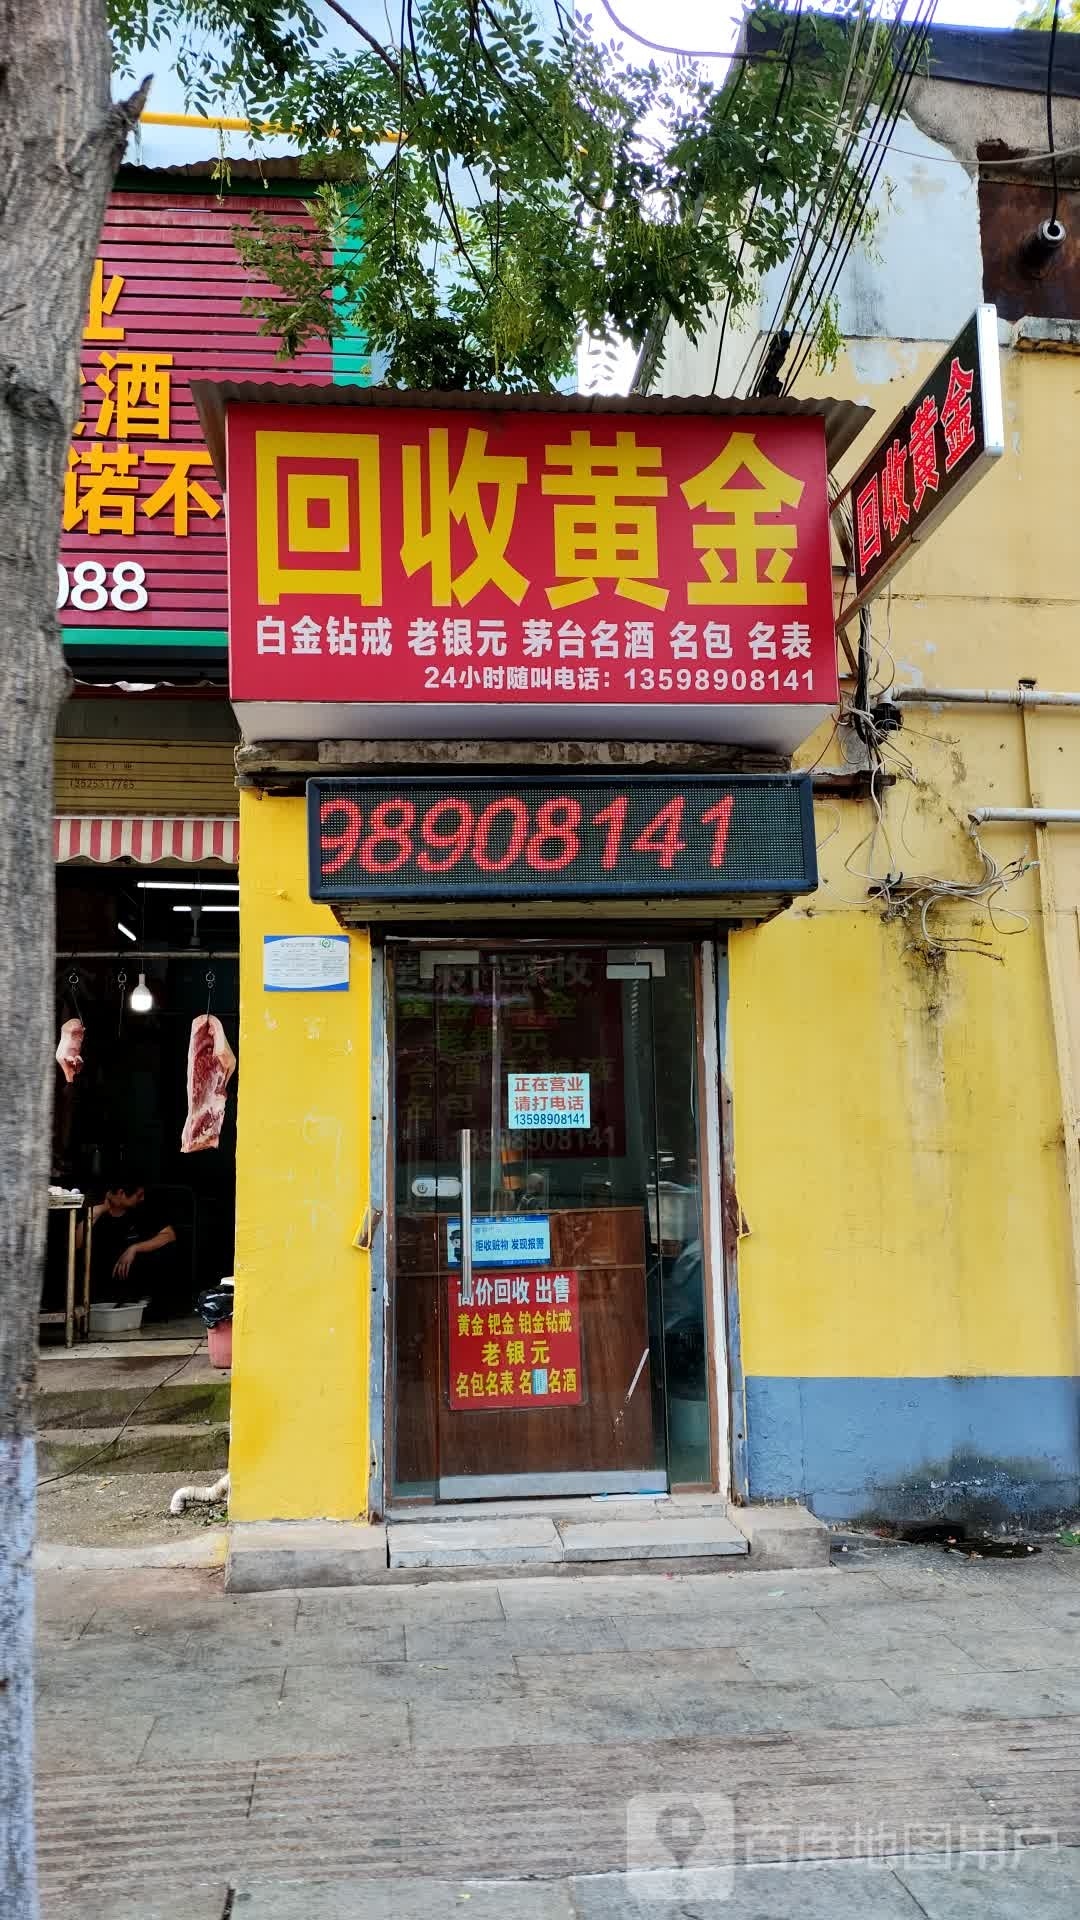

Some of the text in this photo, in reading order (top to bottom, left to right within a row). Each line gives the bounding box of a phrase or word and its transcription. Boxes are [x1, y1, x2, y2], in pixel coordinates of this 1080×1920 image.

[74, 351, 173, 440] 酒
[857, 356, 975, 577] 回收黄金
[255, 427, 808, 612] 回收黄金
[256, 615, 812, 661] 白金钻戒 老银元 茅台名酒 名包 名表
[320, 795, 734, 873] 98908141
[514, 1076, 584, 1092] 正在营业
[514, 1095, 584, 1111] 请打电话
[514, 1113, 585, 1125] 13598908141
[511, 1237, 544, 1250] 发现报警
[535, 1275, 570, 1304] 出售
[458, 1313, 484, 1336] 黄金
[518, 1309, 572, 1334] 铂金钻戒
[456, 1370, 514, 1397] 名包名表
[519, 1368, 577, 1395] 名名酒
